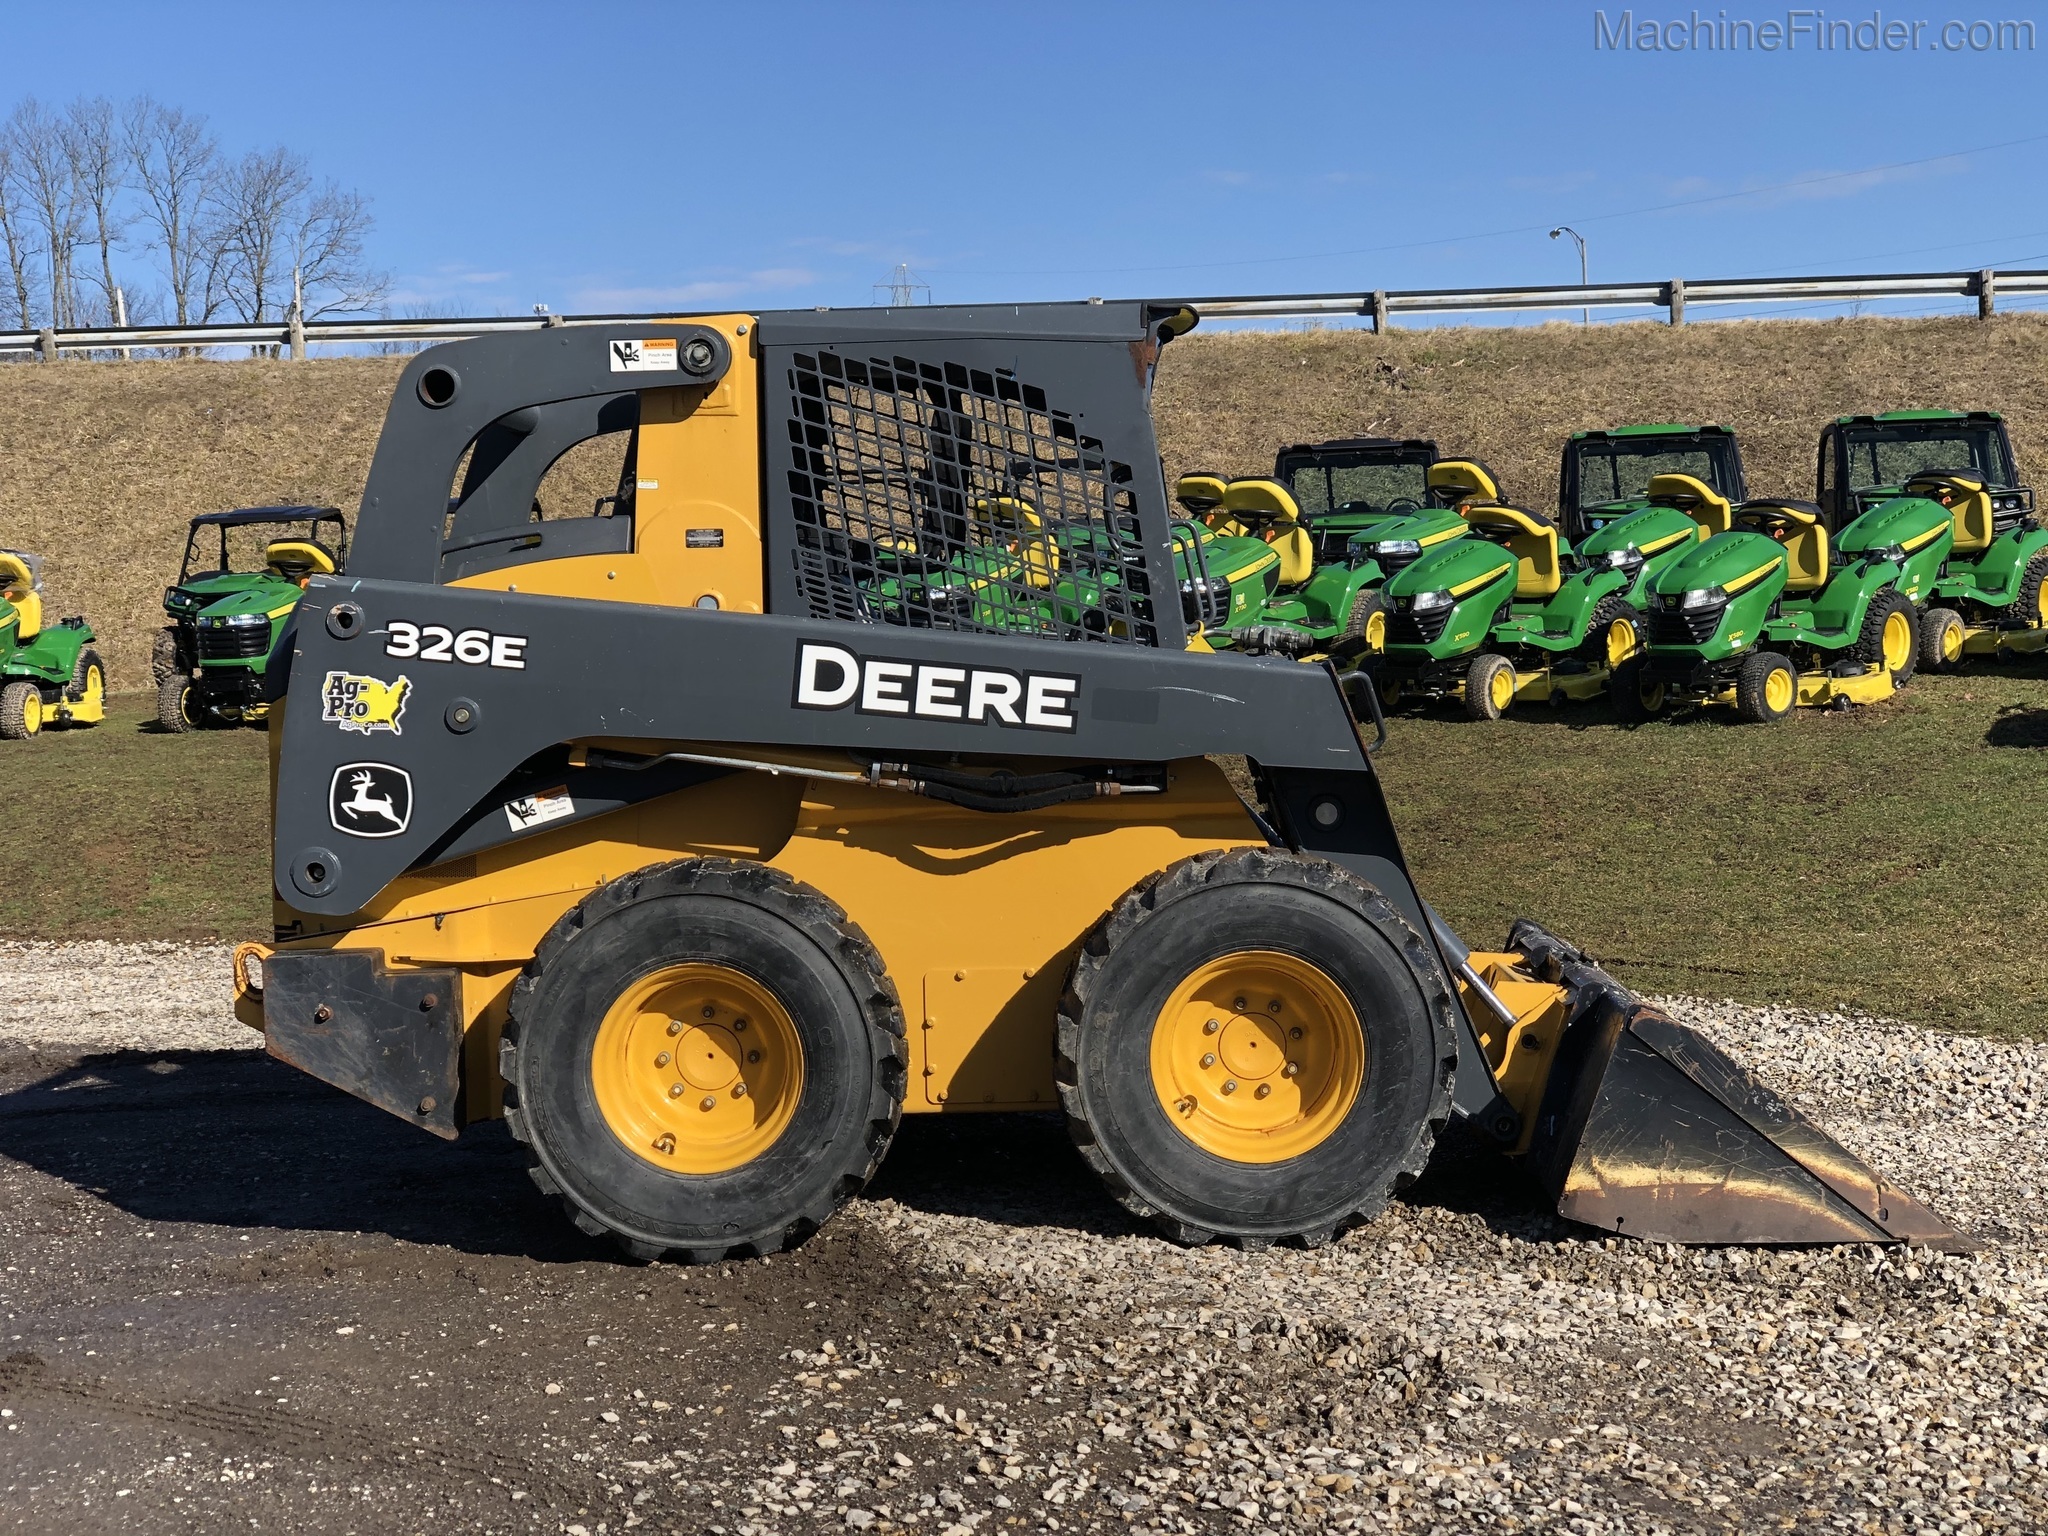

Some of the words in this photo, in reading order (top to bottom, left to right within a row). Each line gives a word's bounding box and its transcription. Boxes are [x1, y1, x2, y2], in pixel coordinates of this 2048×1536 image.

[386, 622, 527, 669] 326E
[327, 675, 368, 700] Ag-
[798, 644, 1077, 728] DEERE
[327, 696, 368, 717] Pro
[342, 720, 389, 729] AgProCo.com
[604, 1204, 740, 1237] GALAXY
